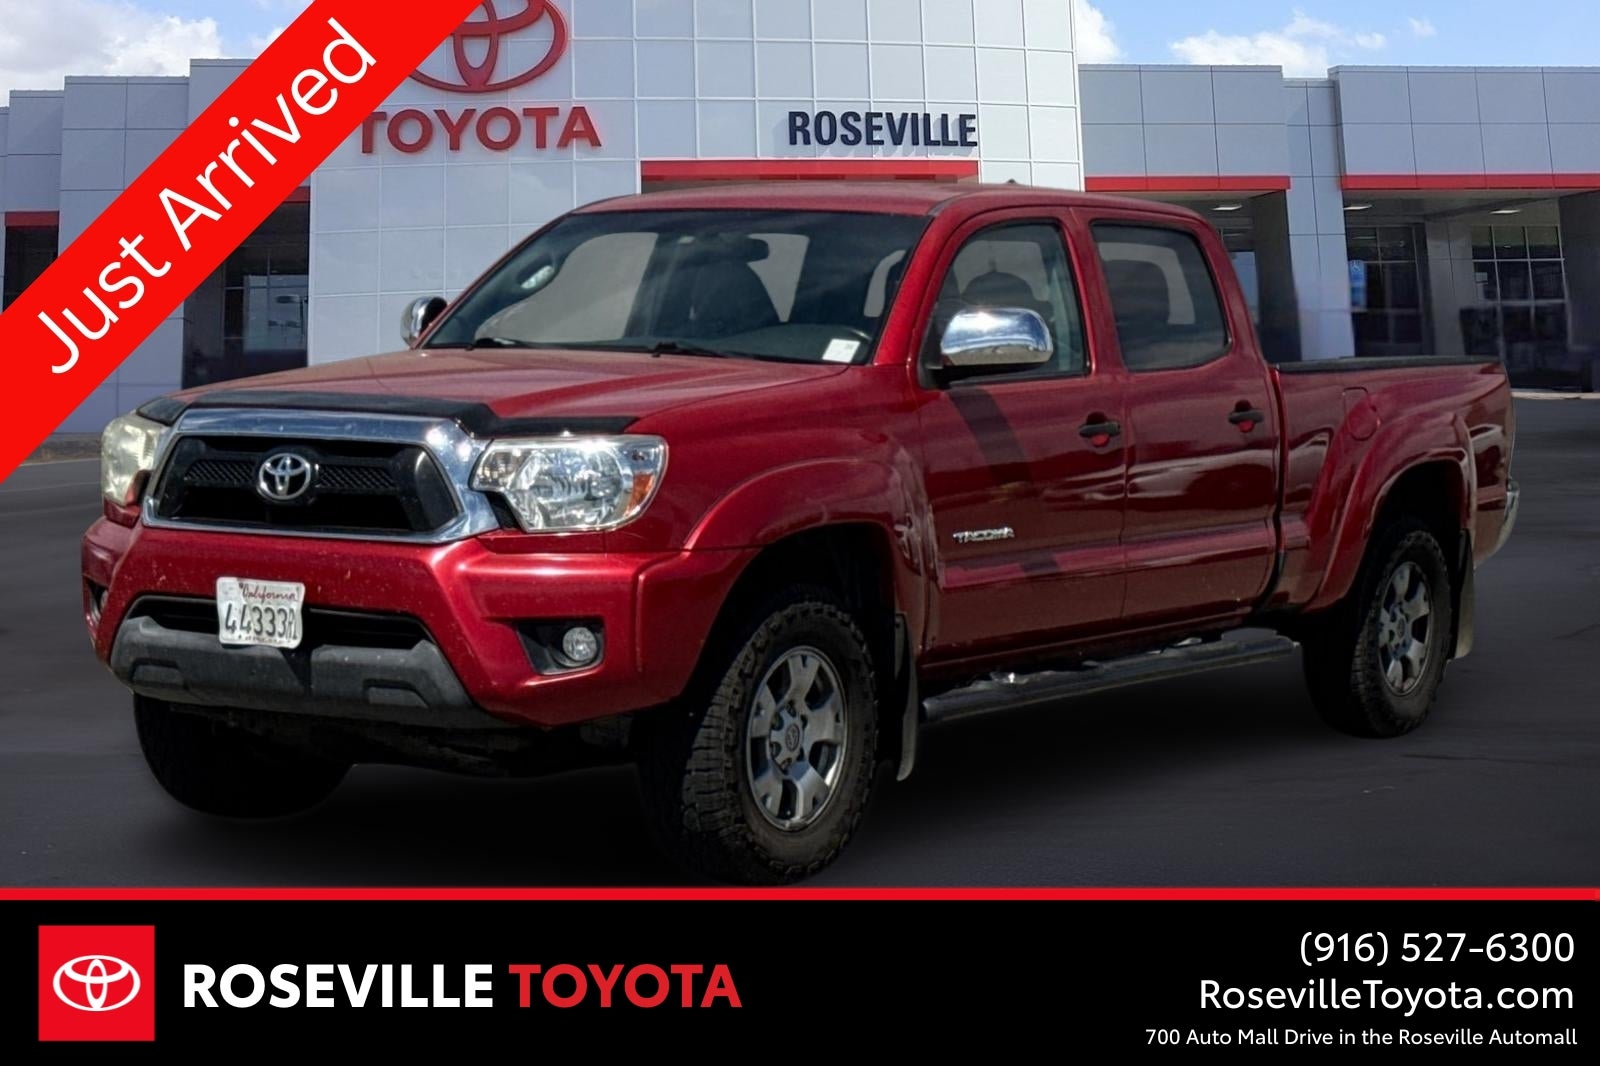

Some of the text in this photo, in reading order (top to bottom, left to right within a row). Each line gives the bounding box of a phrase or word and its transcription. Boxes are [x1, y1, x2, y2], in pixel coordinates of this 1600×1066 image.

[361, 106, 602, 154] TOYOTA
[788, 110, 978, 147] ROSEVILLE
[952, 526, 1015, 543] TACOMA
